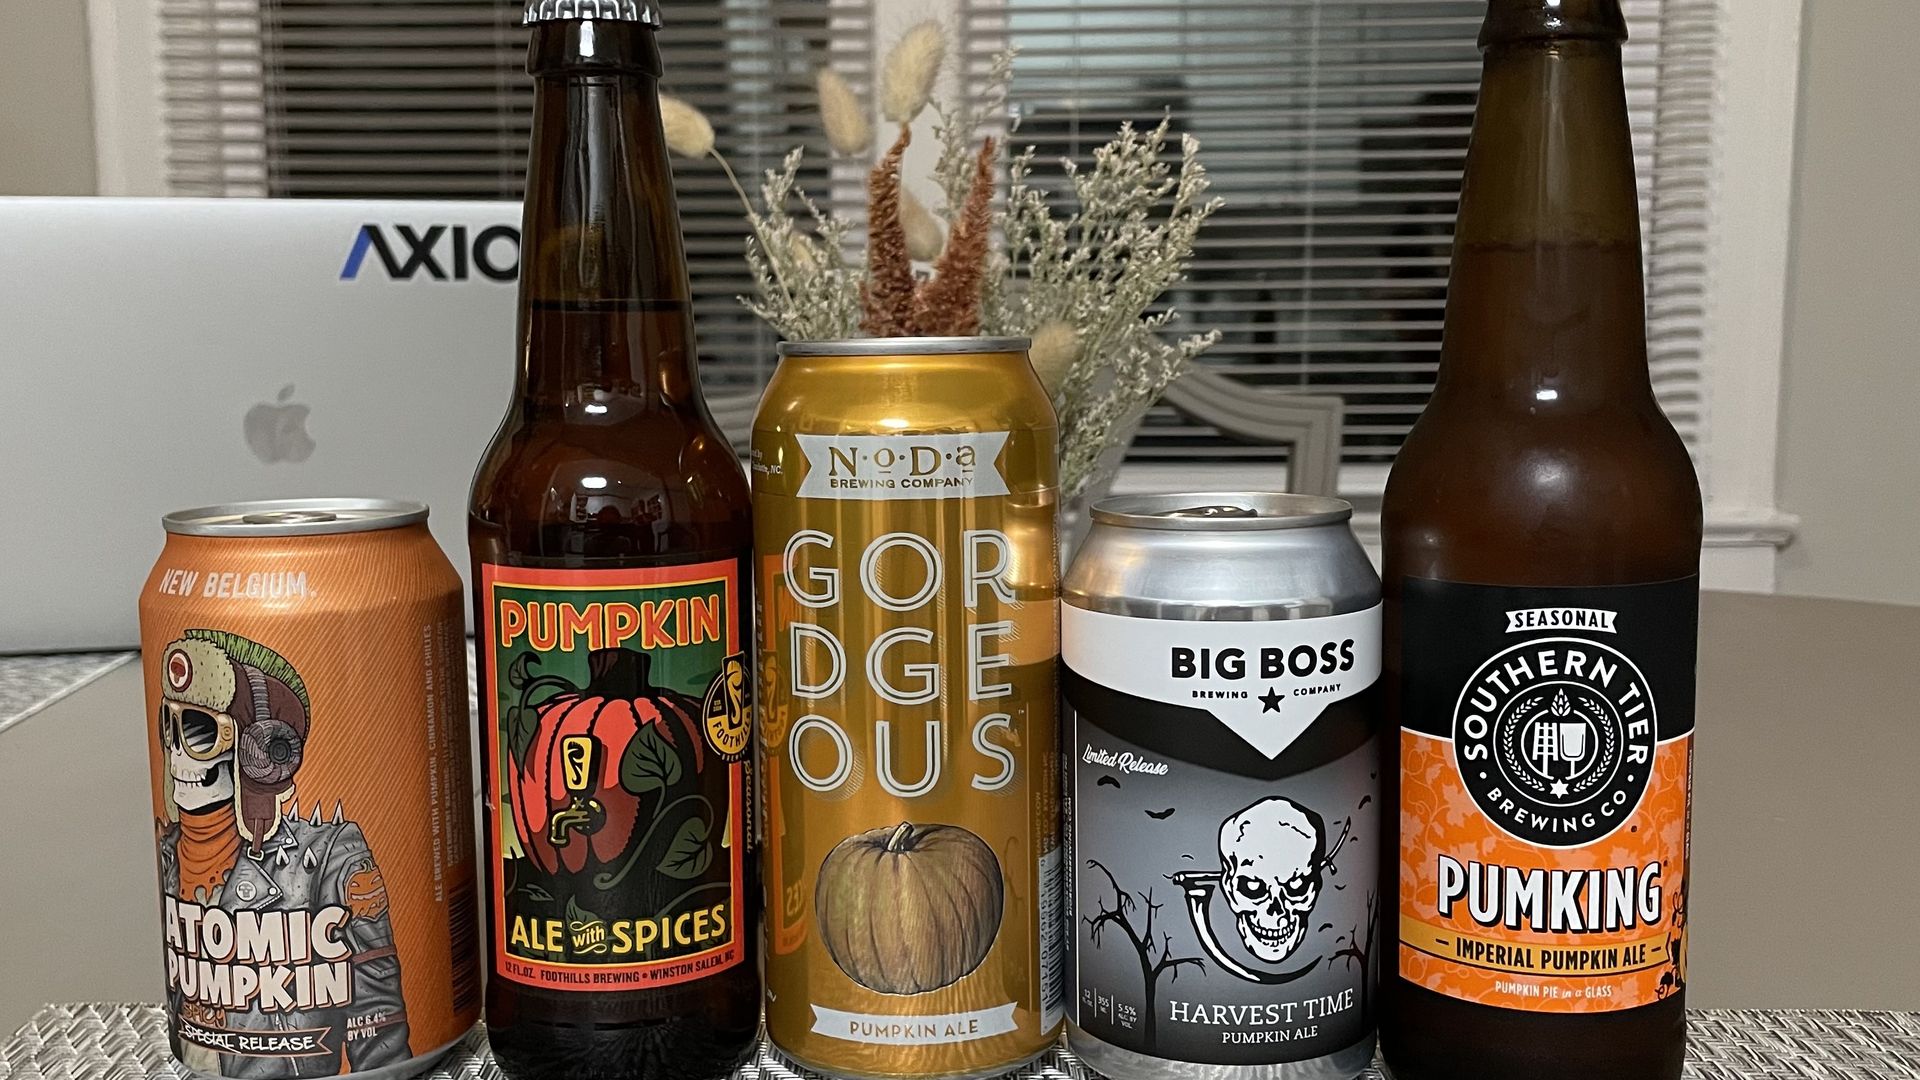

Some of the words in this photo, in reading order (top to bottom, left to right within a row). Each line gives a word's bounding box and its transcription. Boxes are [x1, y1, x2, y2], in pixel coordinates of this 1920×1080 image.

[339, 224, 521, 282] AXIO
[831, 479, 895, 489] BREWING
[901, 477, 973, 489] COMPANY
[159, 568, 199, 596] NEW
[203, 571, 317, 598] BELGIUM.
[783, 529, 1016, 611] GOR
[500, 594, 720, 651] PUMPKIN
[1514, 610, 1609, 628] SEASONAL
[790, 620, 1013, 705] DGE
[1171, 646, 1246, 680] BIG
[1260, 638, 1355, 679] BOSS
[425, 669, 434, 690] AND
[1192, 690, 1248, 699] BREWING
[1293, 683, 1341, 696] COMPANY
[426, 694, 436, 749] CINNAMON
[1463, 649, 1618, 760] SOUTHERN
[1617, 682, 1649, 765] TIER
[788, 713, 1016, 798] OUS
[1082, 744, 1117, 767] Limited
[1118, 752, 1169, 776] Release
[431, 808, 440, 835] WITH
[1486, 787, 1595, 832] BREWING
[1600, 791, 1626, 816] CO
[433, 838, 442, 880] BREWED
[435, 883, 443, 902] ALE
[1438, 854, 1662, 934] PUMKING
[166, 895, 351, 964] ATOMIC
[511, 915, 563, 952] ALE
[572, 926, 605, 948] with
[612, 904, 726, 954] SPICES
[504, 961, 513, 973] 12
[541, 970, 591, 984] FOOTHILLS
[593, 972, 640, 984] BREWING
[650, 965, 694, 981] WINSTON
[724, 950, 735, 963] NC
[1455, 937, 1534, 969] IMPERIAL
[1540, 948, 1618, 970] PUMPKIN
[1623, 943, 1646, 966] ALE
[168, 951, 352, 1011] PUMPKIN
[1084, 989, 1091, 999] 12
[1495, 981, 1540, 998] PUMPKIN
[1542, 985, 1558, 999] PIE
[1561, 989, 1573, 999] in
[1575, 988, 1583, 998] a
[1585, 984, 1612, 999] GLASS
[1097, 995, 1109, 1008] 355
[1117, 1003, 1137, 1016] 5.5%
[1169, 1000, 1298, 1025] HARVEST
[1303, 988, 1353, 1020] TIME
[184, 1024, 237, 1049] SPECIAL
[239, 1036, 316, 1050] RELEASE
[347, 1017, 364, 1029] ALC
[365, 1014, 387, 1028] 6.4%
[347, 1029, 362, 1041] BY
[363, 1027, 378, 1039] VOL
[850, 1020, 936, 1039] PUMPKIN
[944, 1019, 978, 1035] ALE
[1222, 1030, 1290, 1043] PUMPKIN
[1293, 1025, 1318, 1040] ALE
